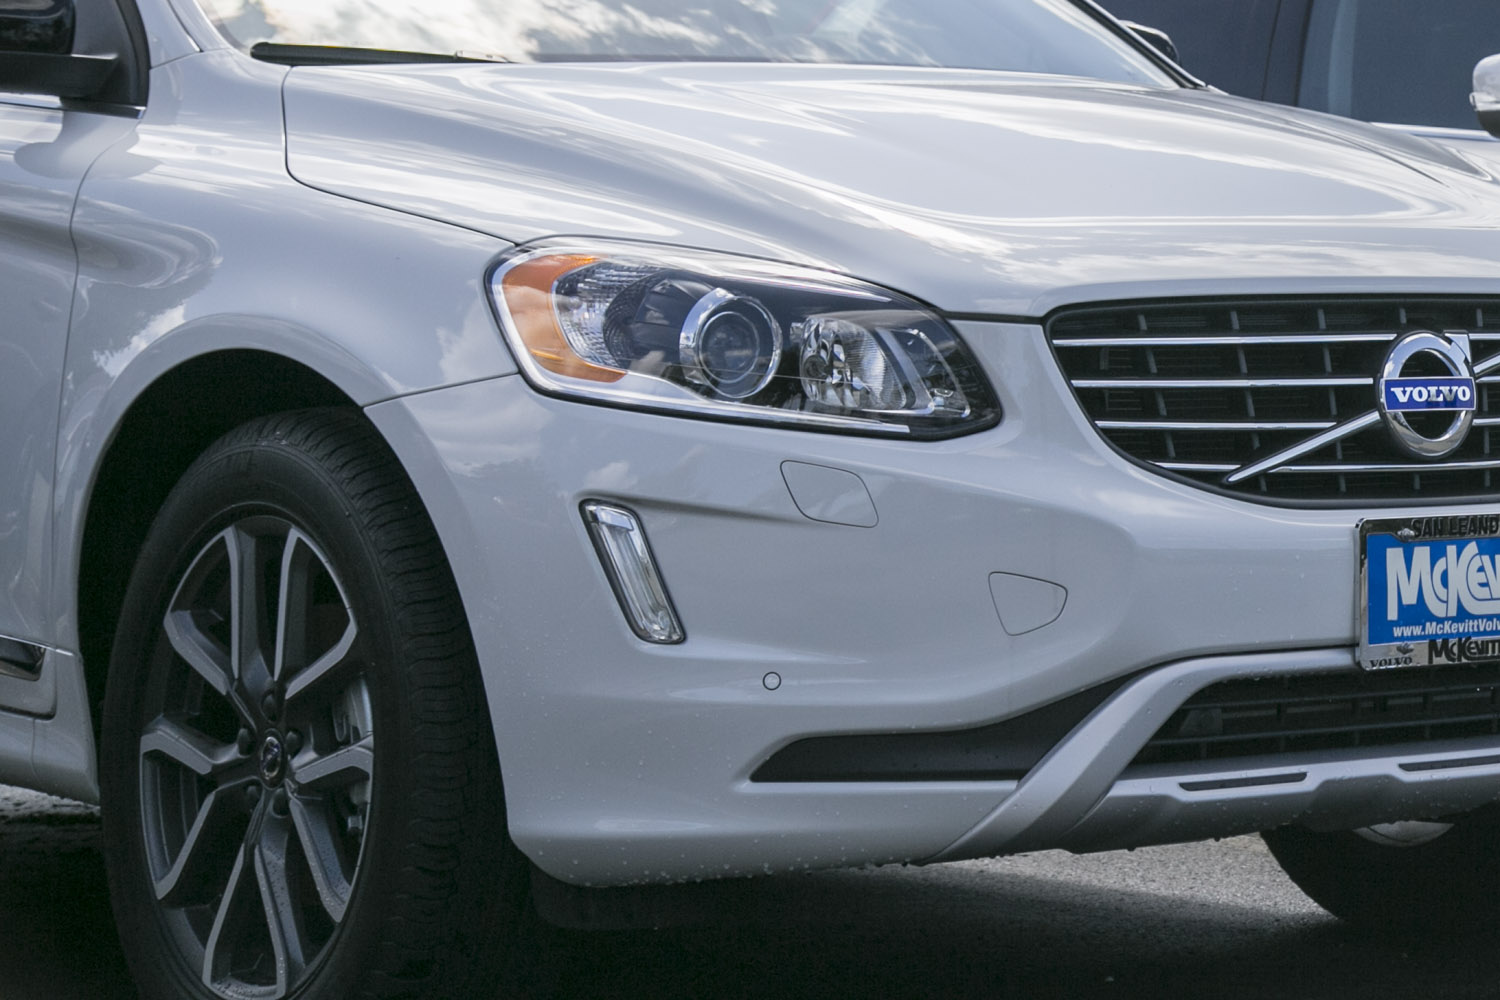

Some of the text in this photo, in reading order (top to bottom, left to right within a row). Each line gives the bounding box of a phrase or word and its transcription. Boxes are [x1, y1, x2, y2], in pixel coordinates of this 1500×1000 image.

[1390, 385, 1471, 403] VOLVO
[1410, 517, 1445, 538] SAN
[1369, 656, 1413, 669] VOLVO
